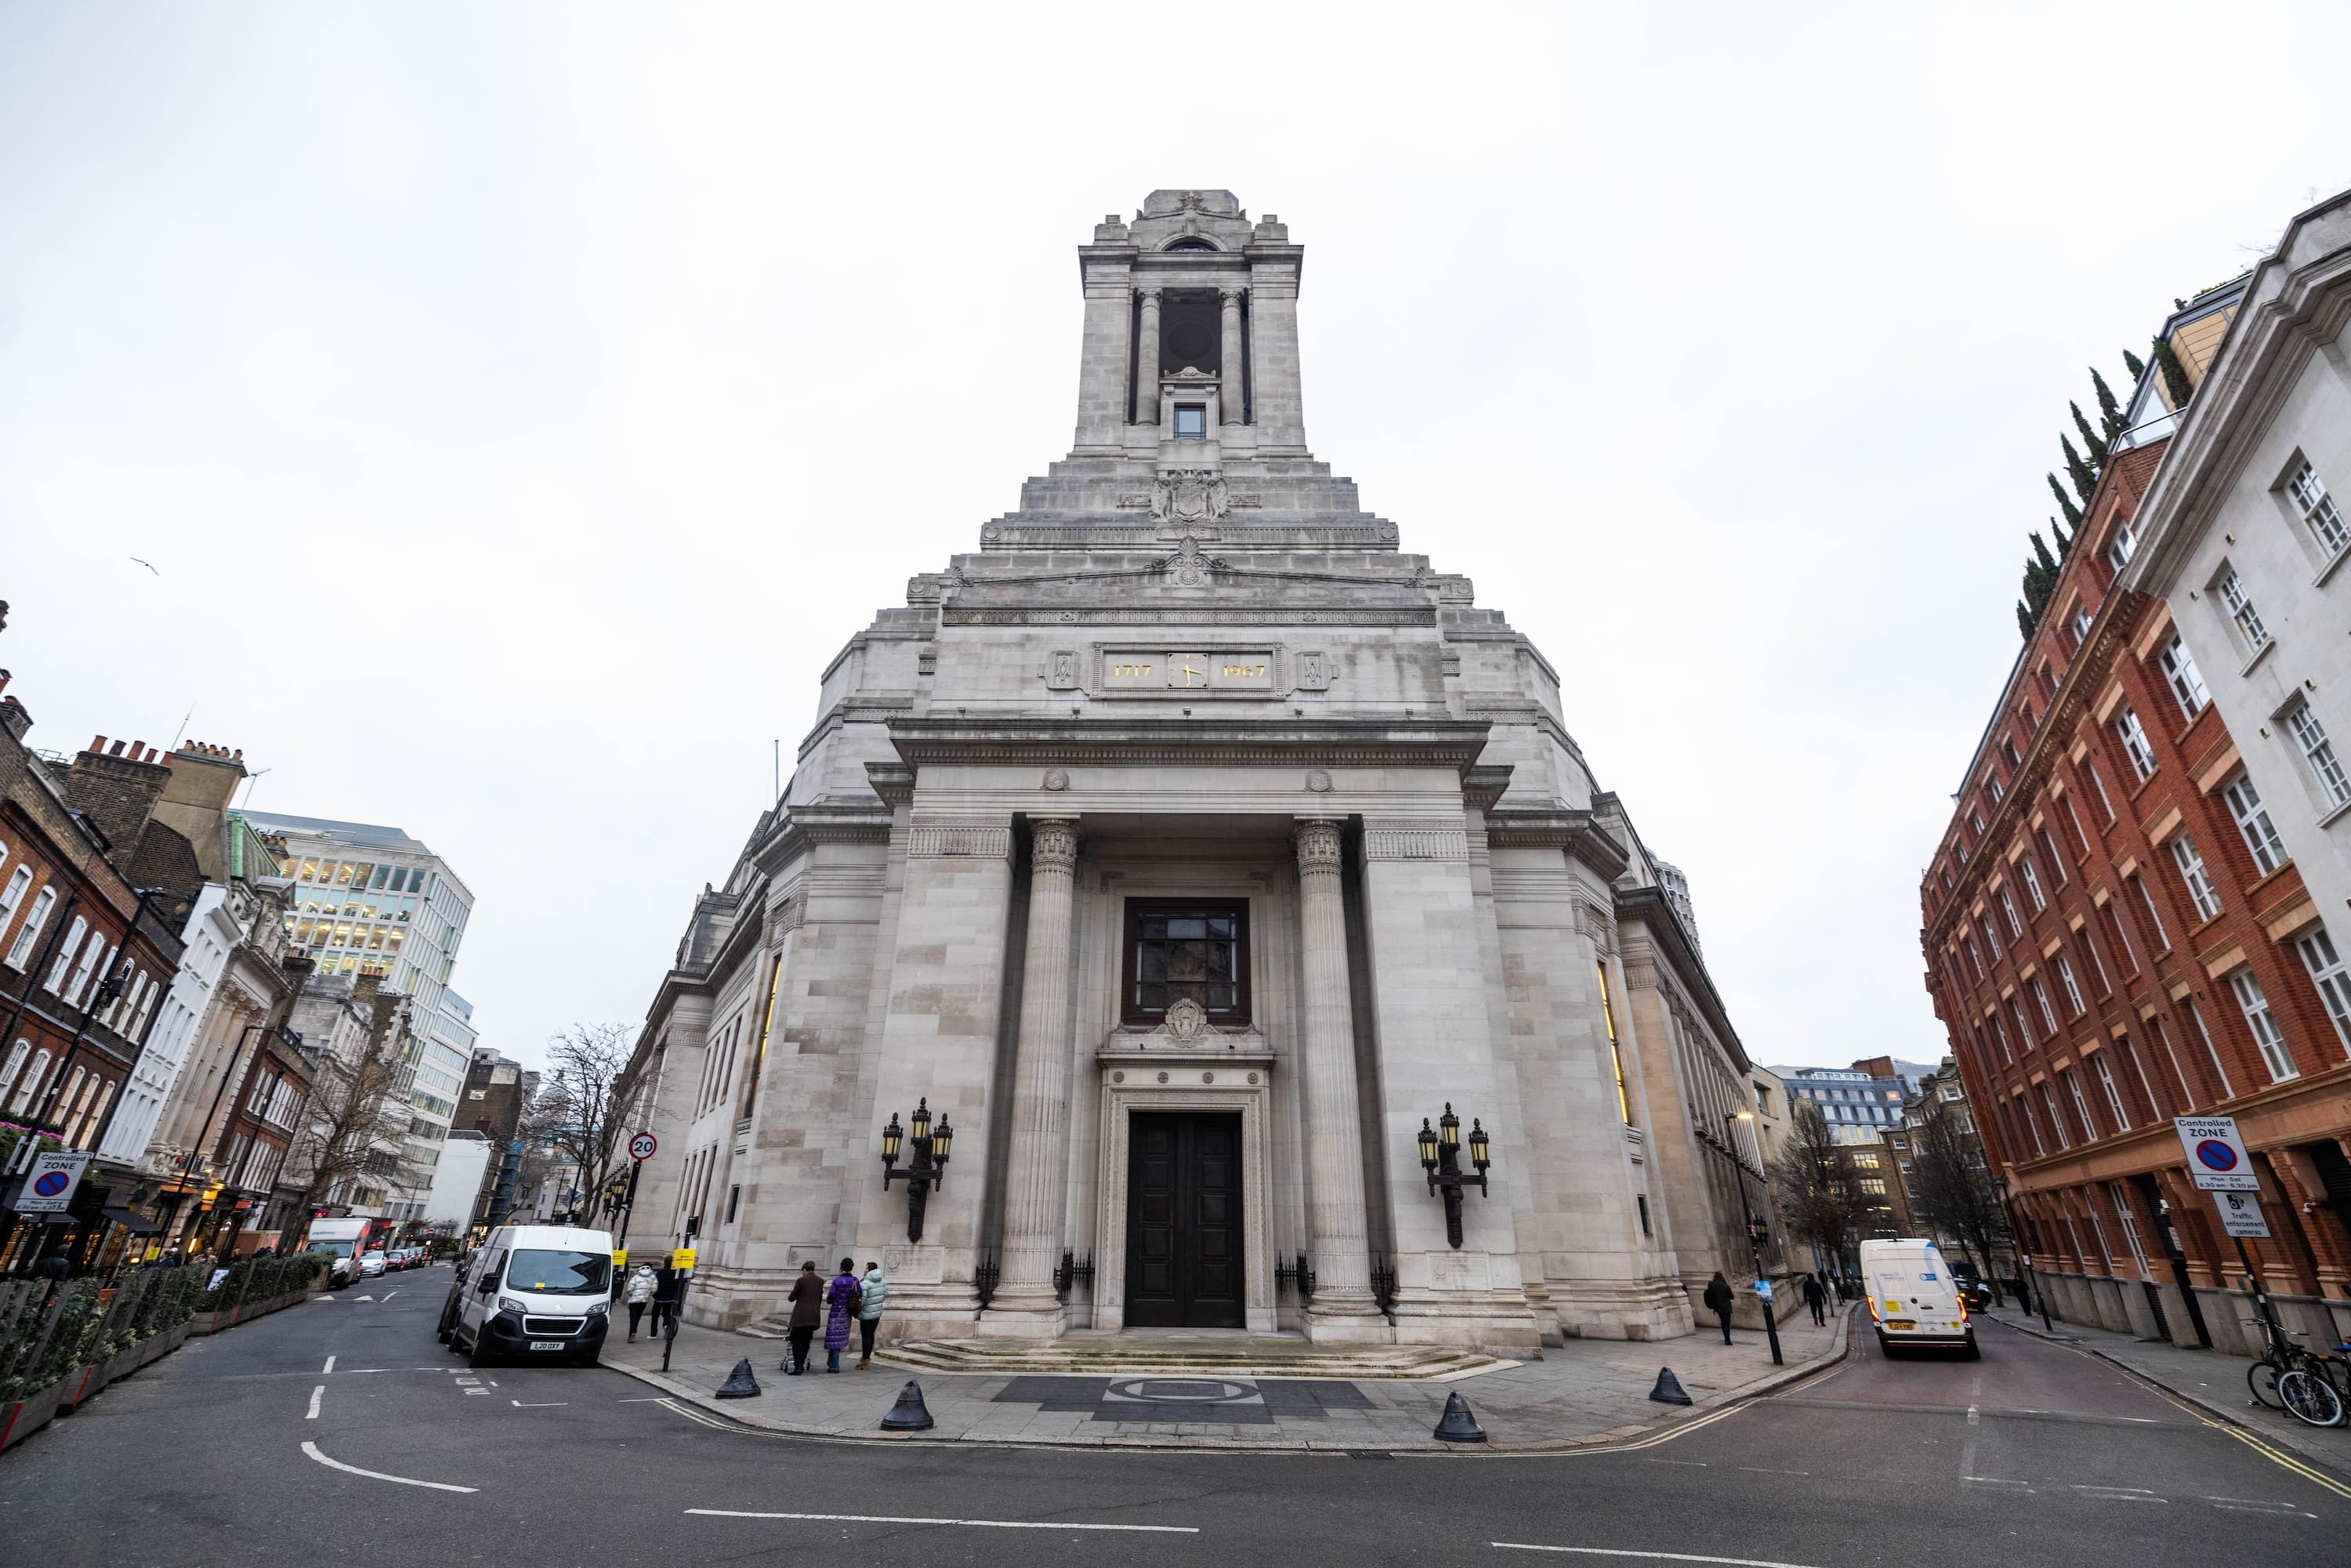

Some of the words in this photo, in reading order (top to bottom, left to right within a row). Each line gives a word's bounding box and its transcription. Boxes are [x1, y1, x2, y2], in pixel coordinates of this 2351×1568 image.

[1115, 664, 1151, 677] 1717
[1223, 665, 1266, 677] 1967
[2189, 1128, 2228, 1137] ZONE
[634, 1141, 653, 1152] 20
